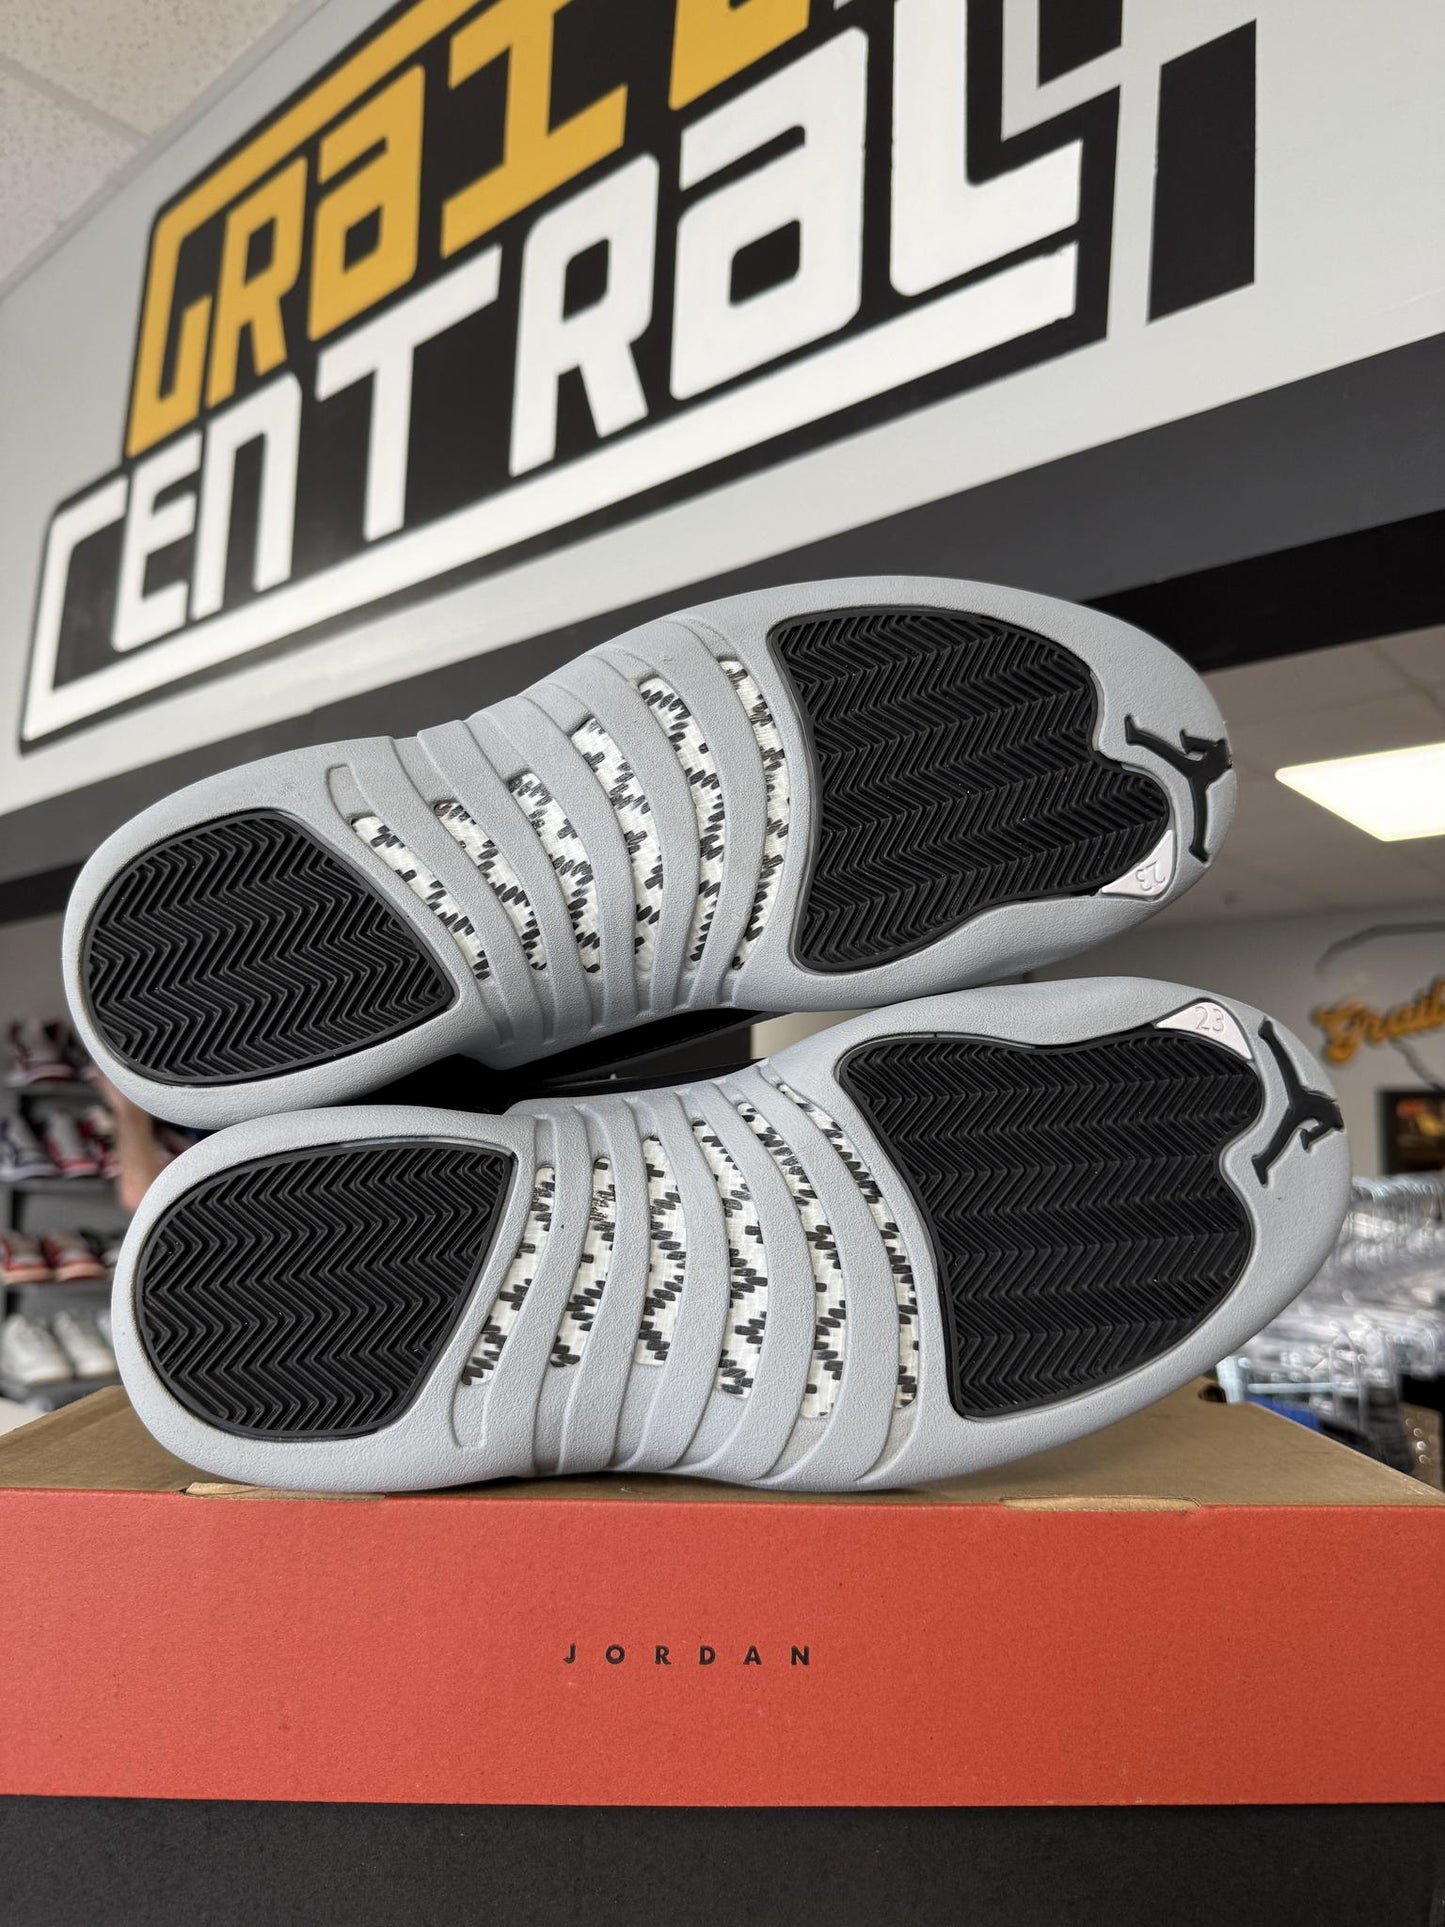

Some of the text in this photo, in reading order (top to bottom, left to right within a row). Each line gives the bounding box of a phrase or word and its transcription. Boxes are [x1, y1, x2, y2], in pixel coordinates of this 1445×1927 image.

[1135, 859, 1166, 892] 23
[1194, 1005, 1225, 1033] 23
[562, 1642, 811, 1667] JORDAN
